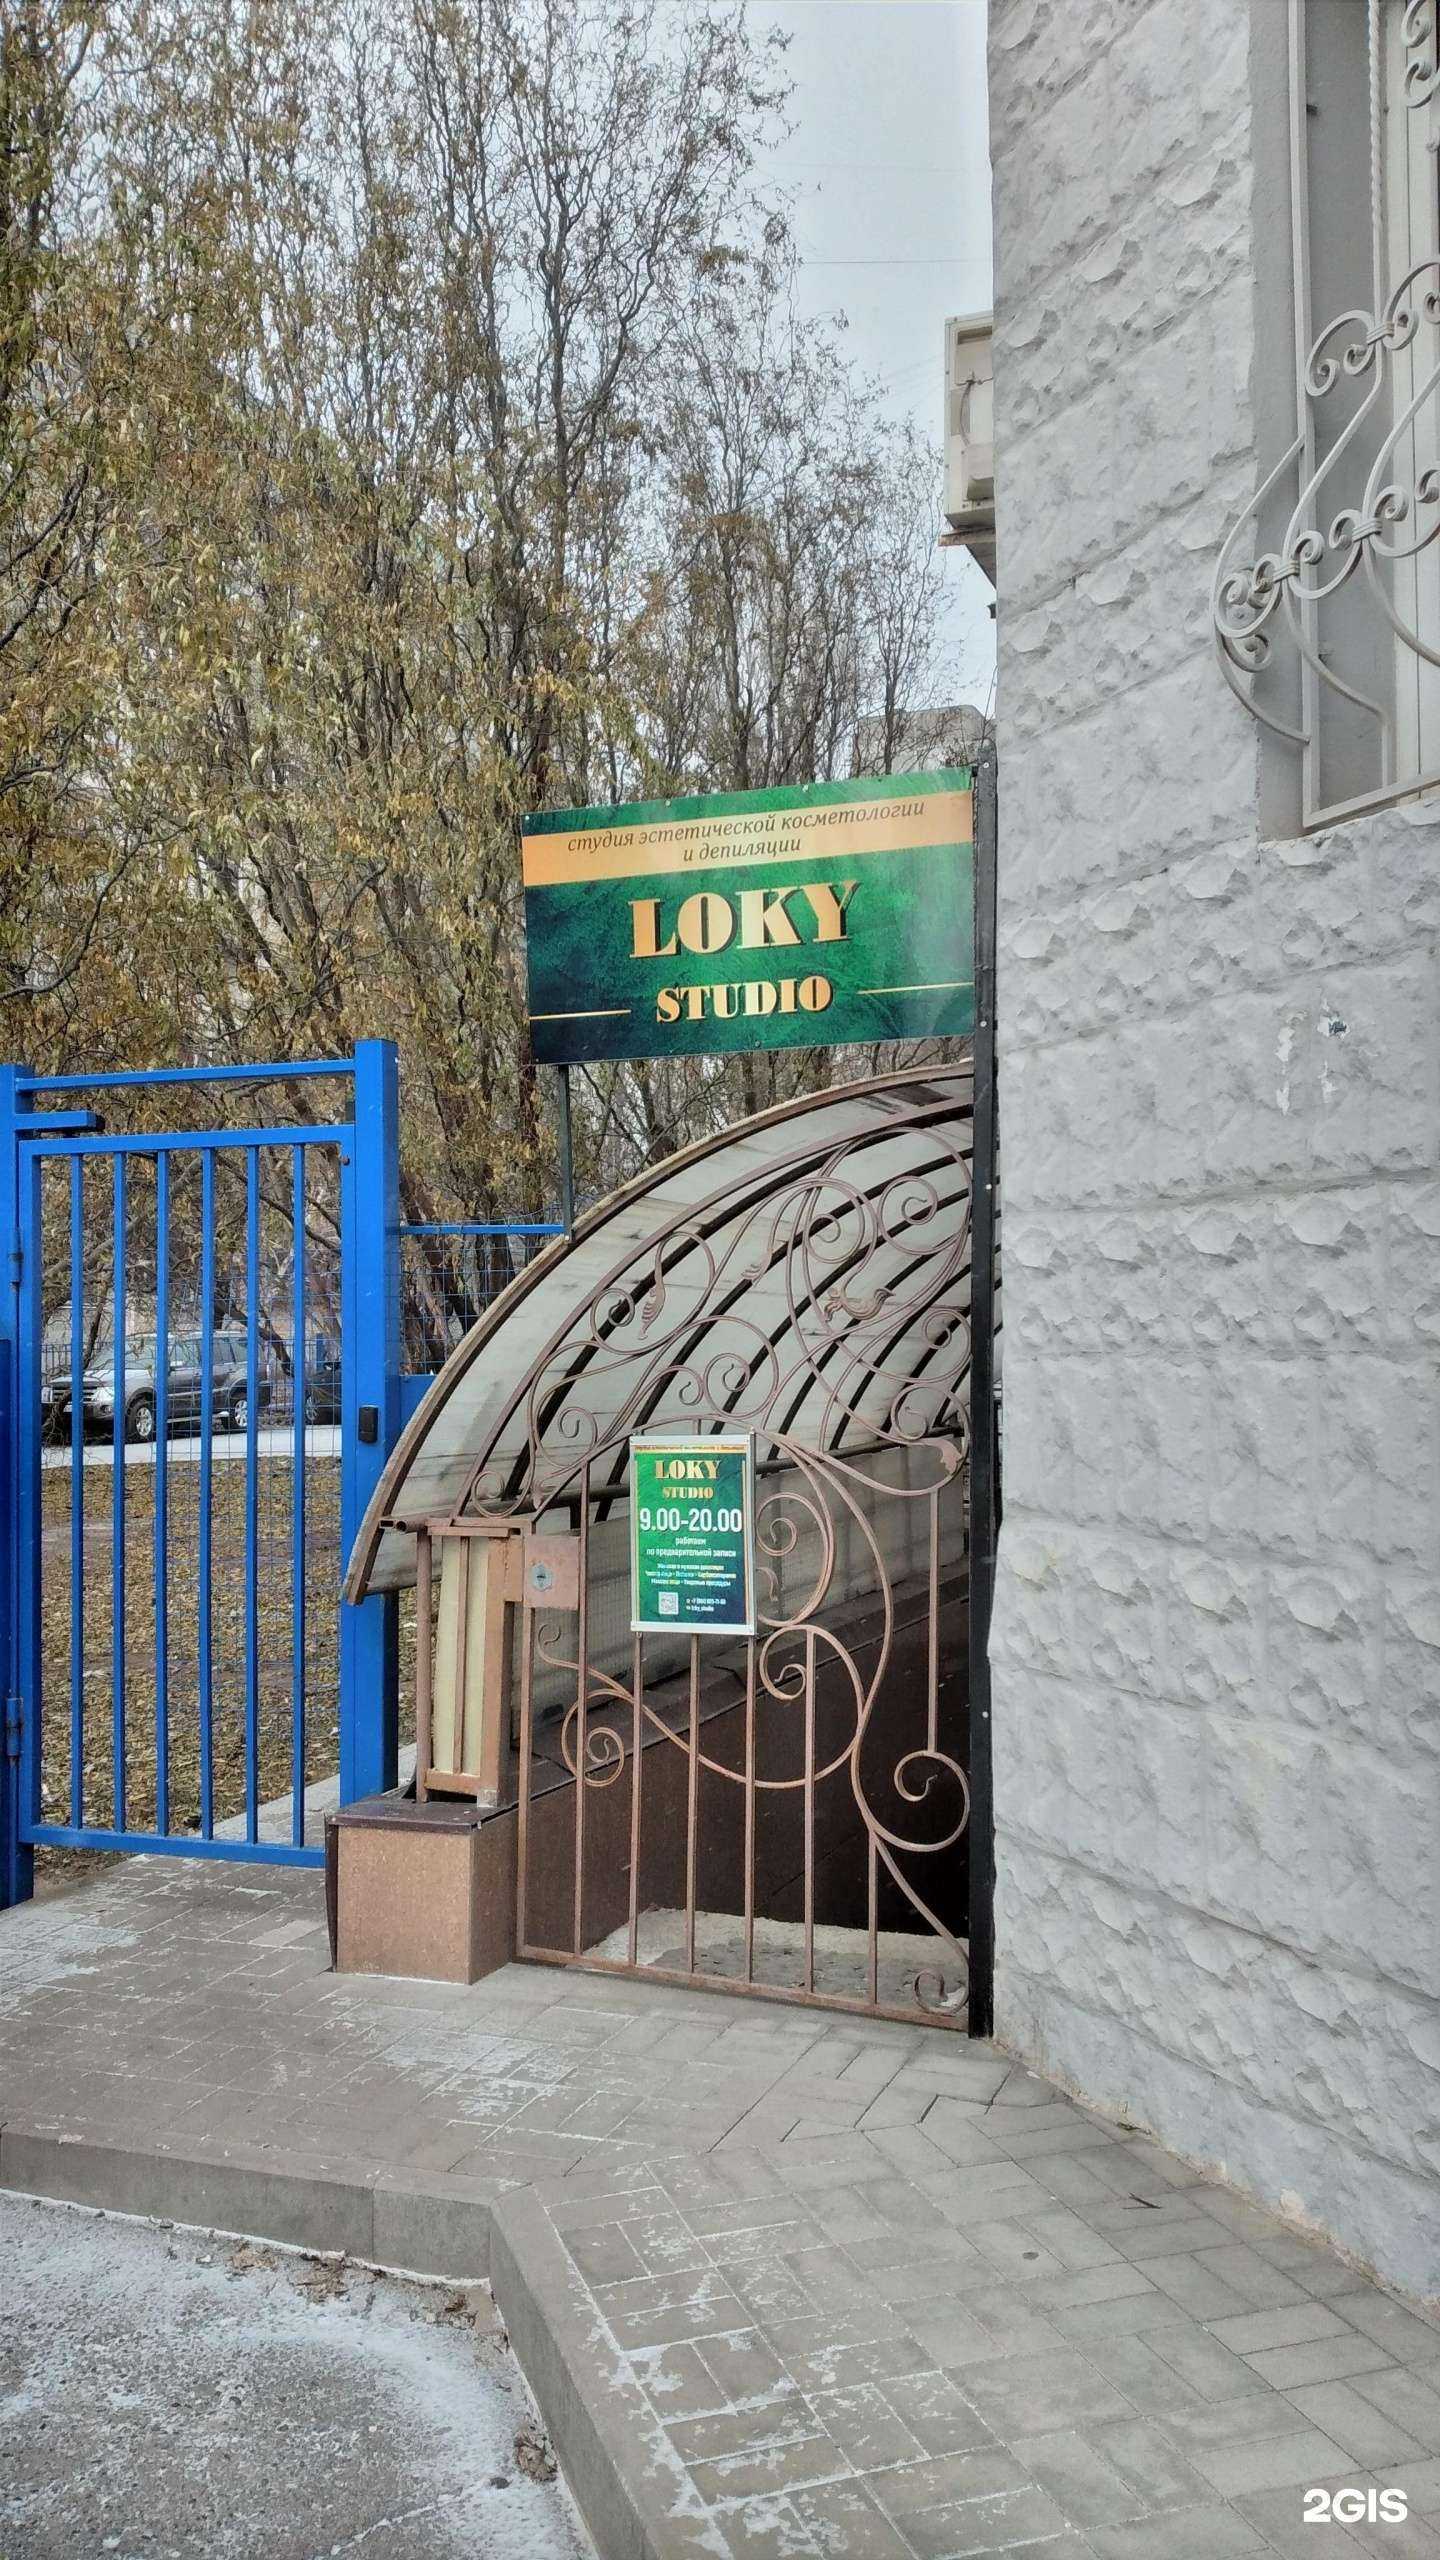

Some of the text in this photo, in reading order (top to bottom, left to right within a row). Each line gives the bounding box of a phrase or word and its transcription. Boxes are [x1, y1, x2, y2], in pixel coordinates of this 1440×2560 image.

[567, 800, 926, 852] студия эстетической косметологии
[682, 836, 802, 863] и депиляции
[628, 879, 862, 959] LOKY
[656, 975, 834, 1023] STUDIO
[655, 1459, 720, 1479] LOKY
[662, 1486, 715, 1499] STUDIO
[640, 1507, 743, 1532] 9.00-20.00
